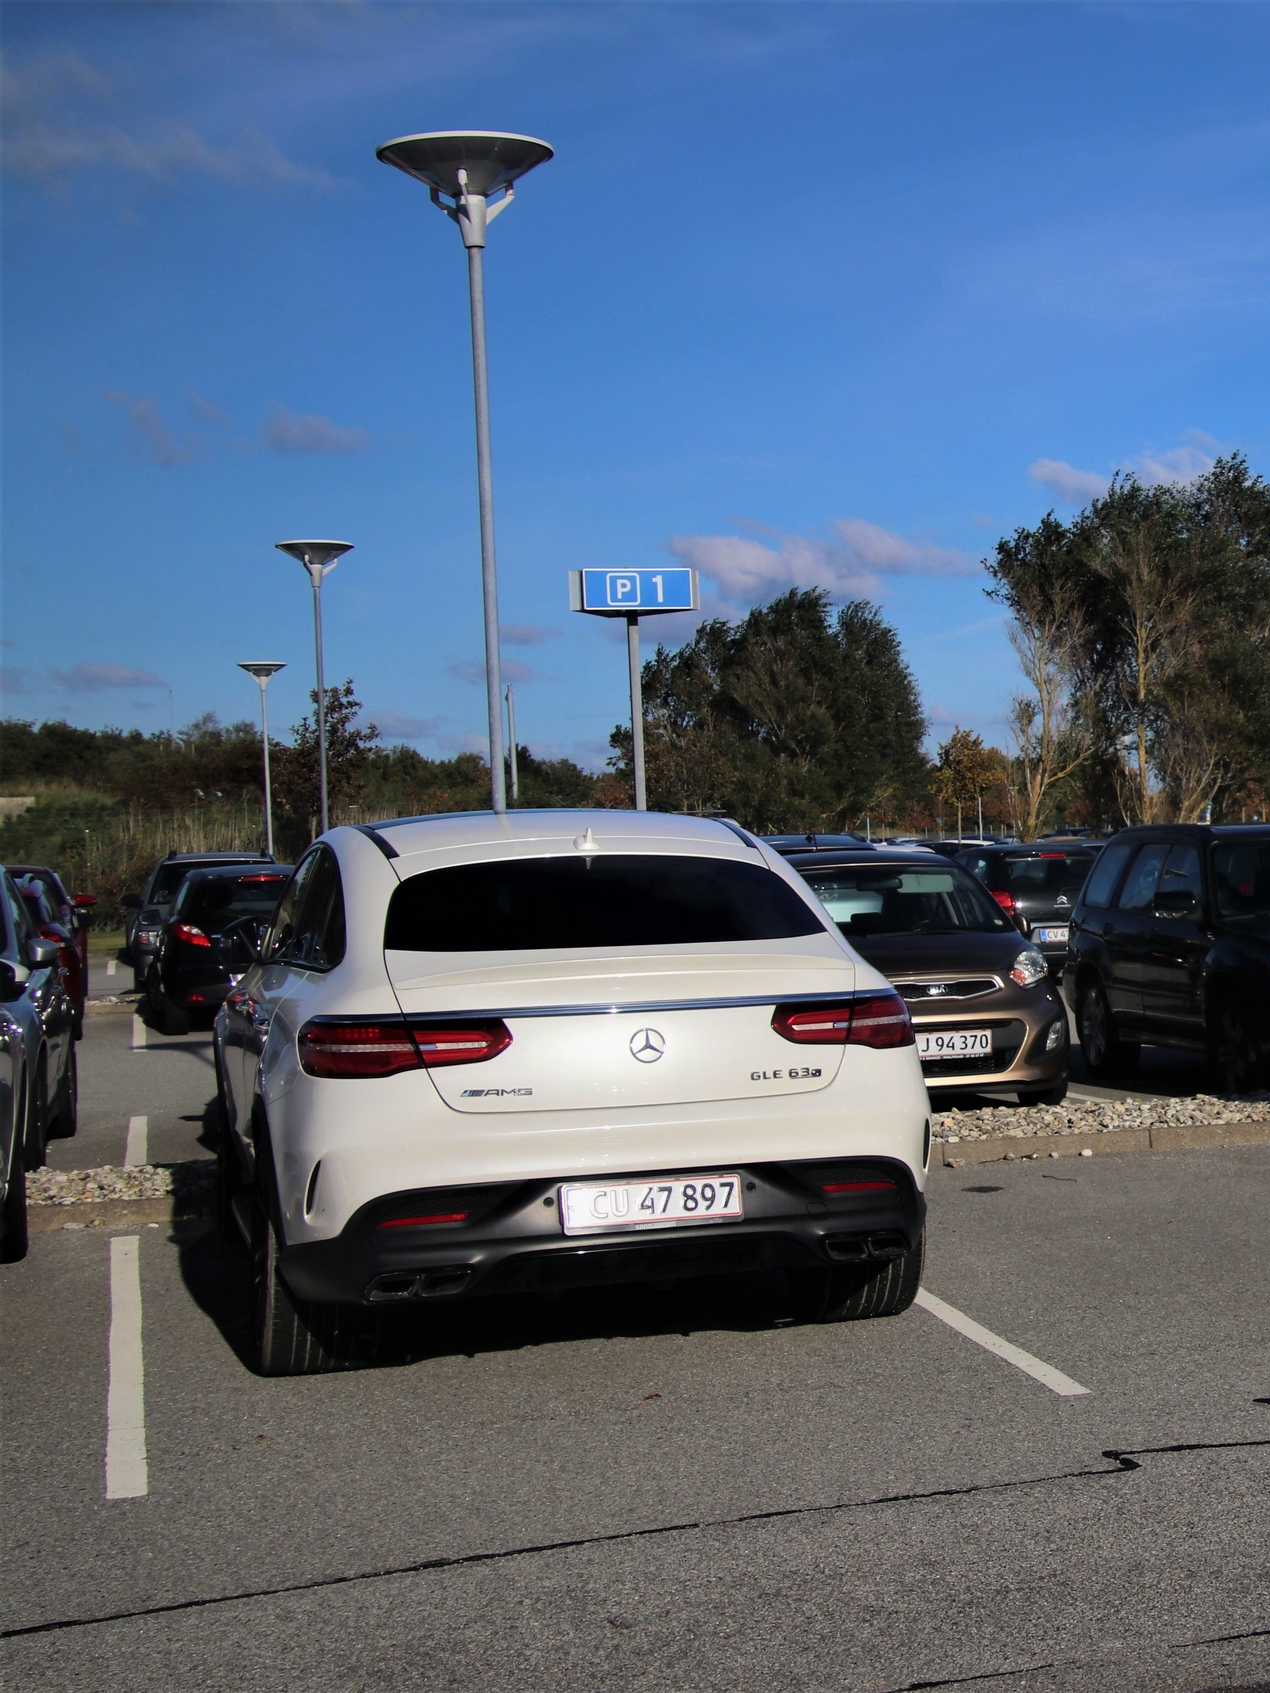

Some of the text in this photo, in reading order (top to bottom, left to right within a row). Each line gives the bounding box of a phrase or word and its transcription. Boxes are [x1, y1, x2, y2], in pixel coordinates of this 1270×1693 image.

[617, 575, 663, 603] P 1
[1047, 930, 1069, 939] CV 4
[935, 1035, 955, 1052] 94
[959, 1034, 989, 1051] 370
[751, 1070, 783, 1081] GLE
[483, 1088, 533, 1097] AMG
[589, 1182, 735, 1218] CU 47 897
